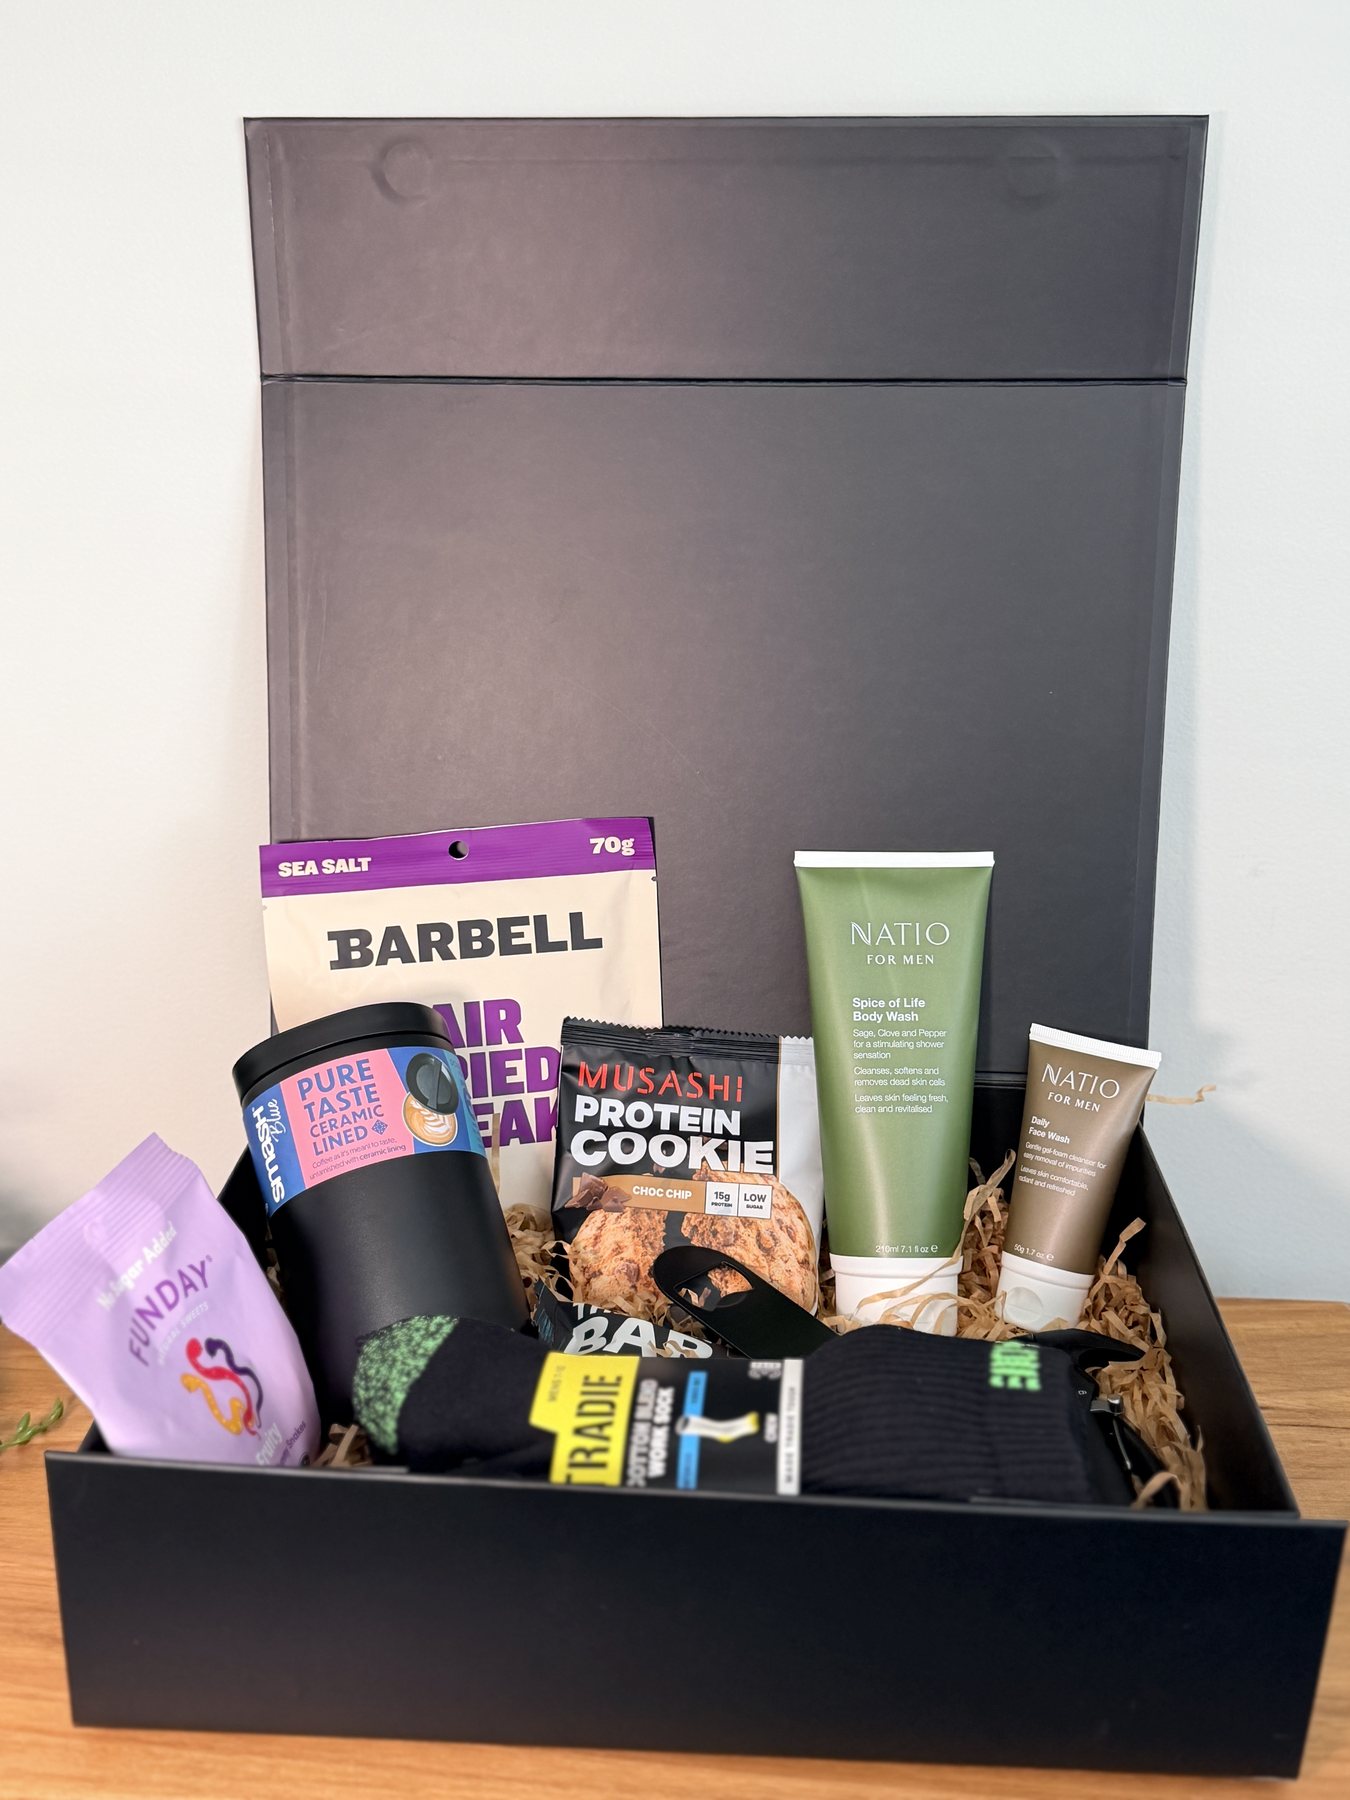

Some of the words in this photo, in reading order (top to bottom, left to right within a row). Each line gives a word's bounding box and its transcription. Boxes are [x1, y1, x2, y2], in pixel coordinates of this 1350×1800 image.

[590, 836, 635, 857] 70g
[278, 860, 318, 877] SEA
[321, 857, 372, 876] SALT
[327, 911, 603, 971] BARBELL
[851, 921, 950, 946] NATIO
[866, 954, 897, 965] FOR
[903, 954, 934, 965] MEN
[852, 997, 886, 1010] Spice
[888, 997, 900, 1008] of
[903, 997, 926, 1008] Life
[853, 1011, 883, 1024] Body
[886, 1011, 919, 1022] Wash
[852, 1028, 876, 1039] Sage,
[877, 1028, 900, 1038] Clove
[901, 1028, 917, 1038] and
[918, 1028, 947, 1039] Pepper
[853, 1040, 864, 1049] for
[865, 1041, 872, 1049] a
[872, 1040, 915, 1050] stimulating
[915, 1040, 945, 1049] shower
[853, 1051, 891, 1060] sensation
[297, 1058, 375, 1101] PURE
[456, 1046, 561, 1099] IED
[577, 1061, 743, 1103] MUSASHI
[853, 1066, 893, 1077] Cleanses,
[894, 1066, 923, 1075] softens
[924, 1066, 940, 1075] and
[854, 1079, 888, 1087] removes
[889, 1078, 910, 1087] dead
[911, 1078, 927, 1087] skin
[928, 1078, 946, 1087] cells
[1041, 1063, 1120, 1099] NATIO
[303, 1083, 380, 1123] TASTE
[854, 1093, 883, 1102] Leaves
[884, 1093, 900, 1102] skin
[902, 1093, 927, 1104] feeling
[928, 1093, 949, 1103] fresh,
[855, 1105, 876, 1113] clean
[877, 1105, 893, 1113] and
[895, 1105, 933, 1113] revitalised
[1048, 1091, 1071, 1106] FOR
[1074, 1098, 1100, 1113] MEN
[268, 1098, 287, 1143] Blue
[309, 1104, 384, 1138] CERAMIC
[473, 1096, 558, 1147] EAK
[574, 1094, 741, 1136] PROTEIN
[1031, 1115, 1050, 1129] Daily
[313, 1125, 369, 1157] LINED
[1028, 1126, 1046, 1138] Face
[1047, 1131, 1070, 1144] Wash
[312, 1156, 333, 1169] Coffee
[349, 1143, 371, 1155] meant
[371, 1141, 379, 1149] to
[345, 1155, 360, 1167] with
[359, 1148, 387, 1161] ceramic
[386, 1144, 407, 1155] lining
[570, 1130, 774, 1175] COOKIE
[1025, 1141, 1042, 1151] Gentle
[1041, 1147, 1068, 1159] gel-foam
[1068, 1153, 1096, 1166] cleanser
[1096, 1160, 1107, 1169] for
[1020, 1164, 1037, 1175] Leaves
[1037, 1168, 1050, 1179] skin
[1023, 1152, 1034, 1161] easy
[1034, 1155, 1058, 1166] removal
[1057, 1160, 1065, 1168] of
[1065, 1163, 1096, 1177] impurities
[632, 1185, 665, 1199] CHOC
[665, 1187, 692, 1200] CHIP
[713, 1191, 731, 1203] 15g
[743, 1192, 767, 1203] LOW
[1034, 1178, 1046, 1188] and
[1046, 1182, 1076, 1196] refreshed
[711, 1201, 733, 1209] PROTEIN
[142, 1220, 177, 1264] Added
[875, 1245, 899, 1253] 210ml
[901, 1245, 912, 1253] 7.1
[914, 1245, 919, 1253] fl
[1013, 1243, 1025, 1254] 50g
[1025, 1246, 1036, 1256] 1.7
[128, 1260, 208, 1367] FUNDAY
[179, 1301, 209, 1328] SWEETS
[653, 1386, 675, 1424] SOCK
[647, 1425, 670, 1478] WORK
